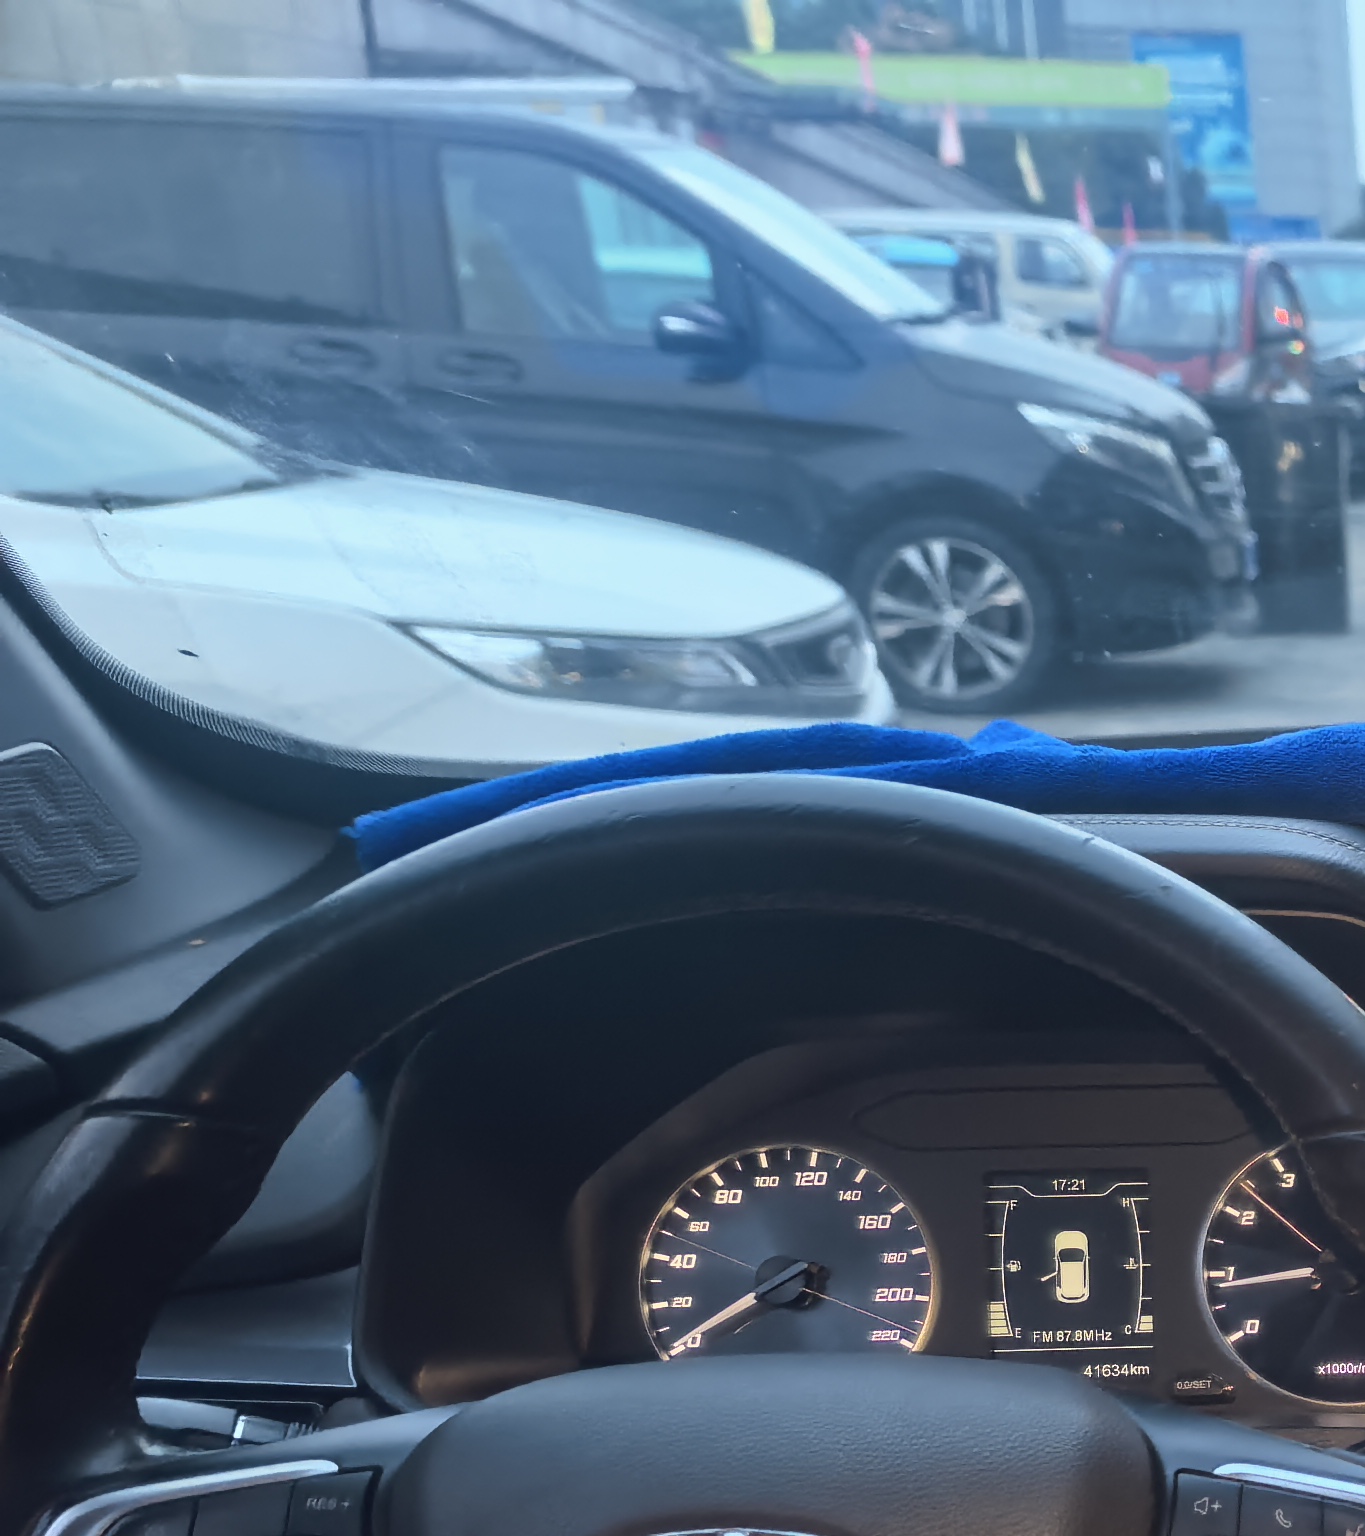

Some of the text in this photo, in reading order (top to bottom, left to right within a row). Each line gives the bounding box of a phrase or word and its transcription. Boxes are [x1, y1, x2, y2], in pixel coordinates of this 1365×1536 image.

[754, 1176, 780, 1187] 100
[794, 1171, 828, 1186] 120
[1052, 1179, 1086, 1191] 17:21
[1282, 1173, 1295, 1188] 3
[714, 1189, 743, 1204] 80
[838, 1190, 862, 1201] 140
[1122, 1197, 1130, 1207] H
[1010, 1200, 1018, 1210] F
[858, 1214, 892, 1230] 160
[1240, 1210, 1255, 1225] 2
[690, 1221, 710, 1232] 60
[669, 1254, 697, 1269] 40
[881, 1252, 907, 1263] 180
[1226, 1266, 1235, 1281] 1
[875, 1287, 914, 1302] 200
[672, 1297, 693, 1308] 20
[1015, 1327, 1022, 1338] E
[1124, 1325, 1132, 1335] C
[1245, 1319, 1260, 1334] 0
[687, 1333, 702, 1348] 0
[870, 1329, 901, 1341] 220
[1033, 1329, 1112, 1343] FM 87.8MHz
